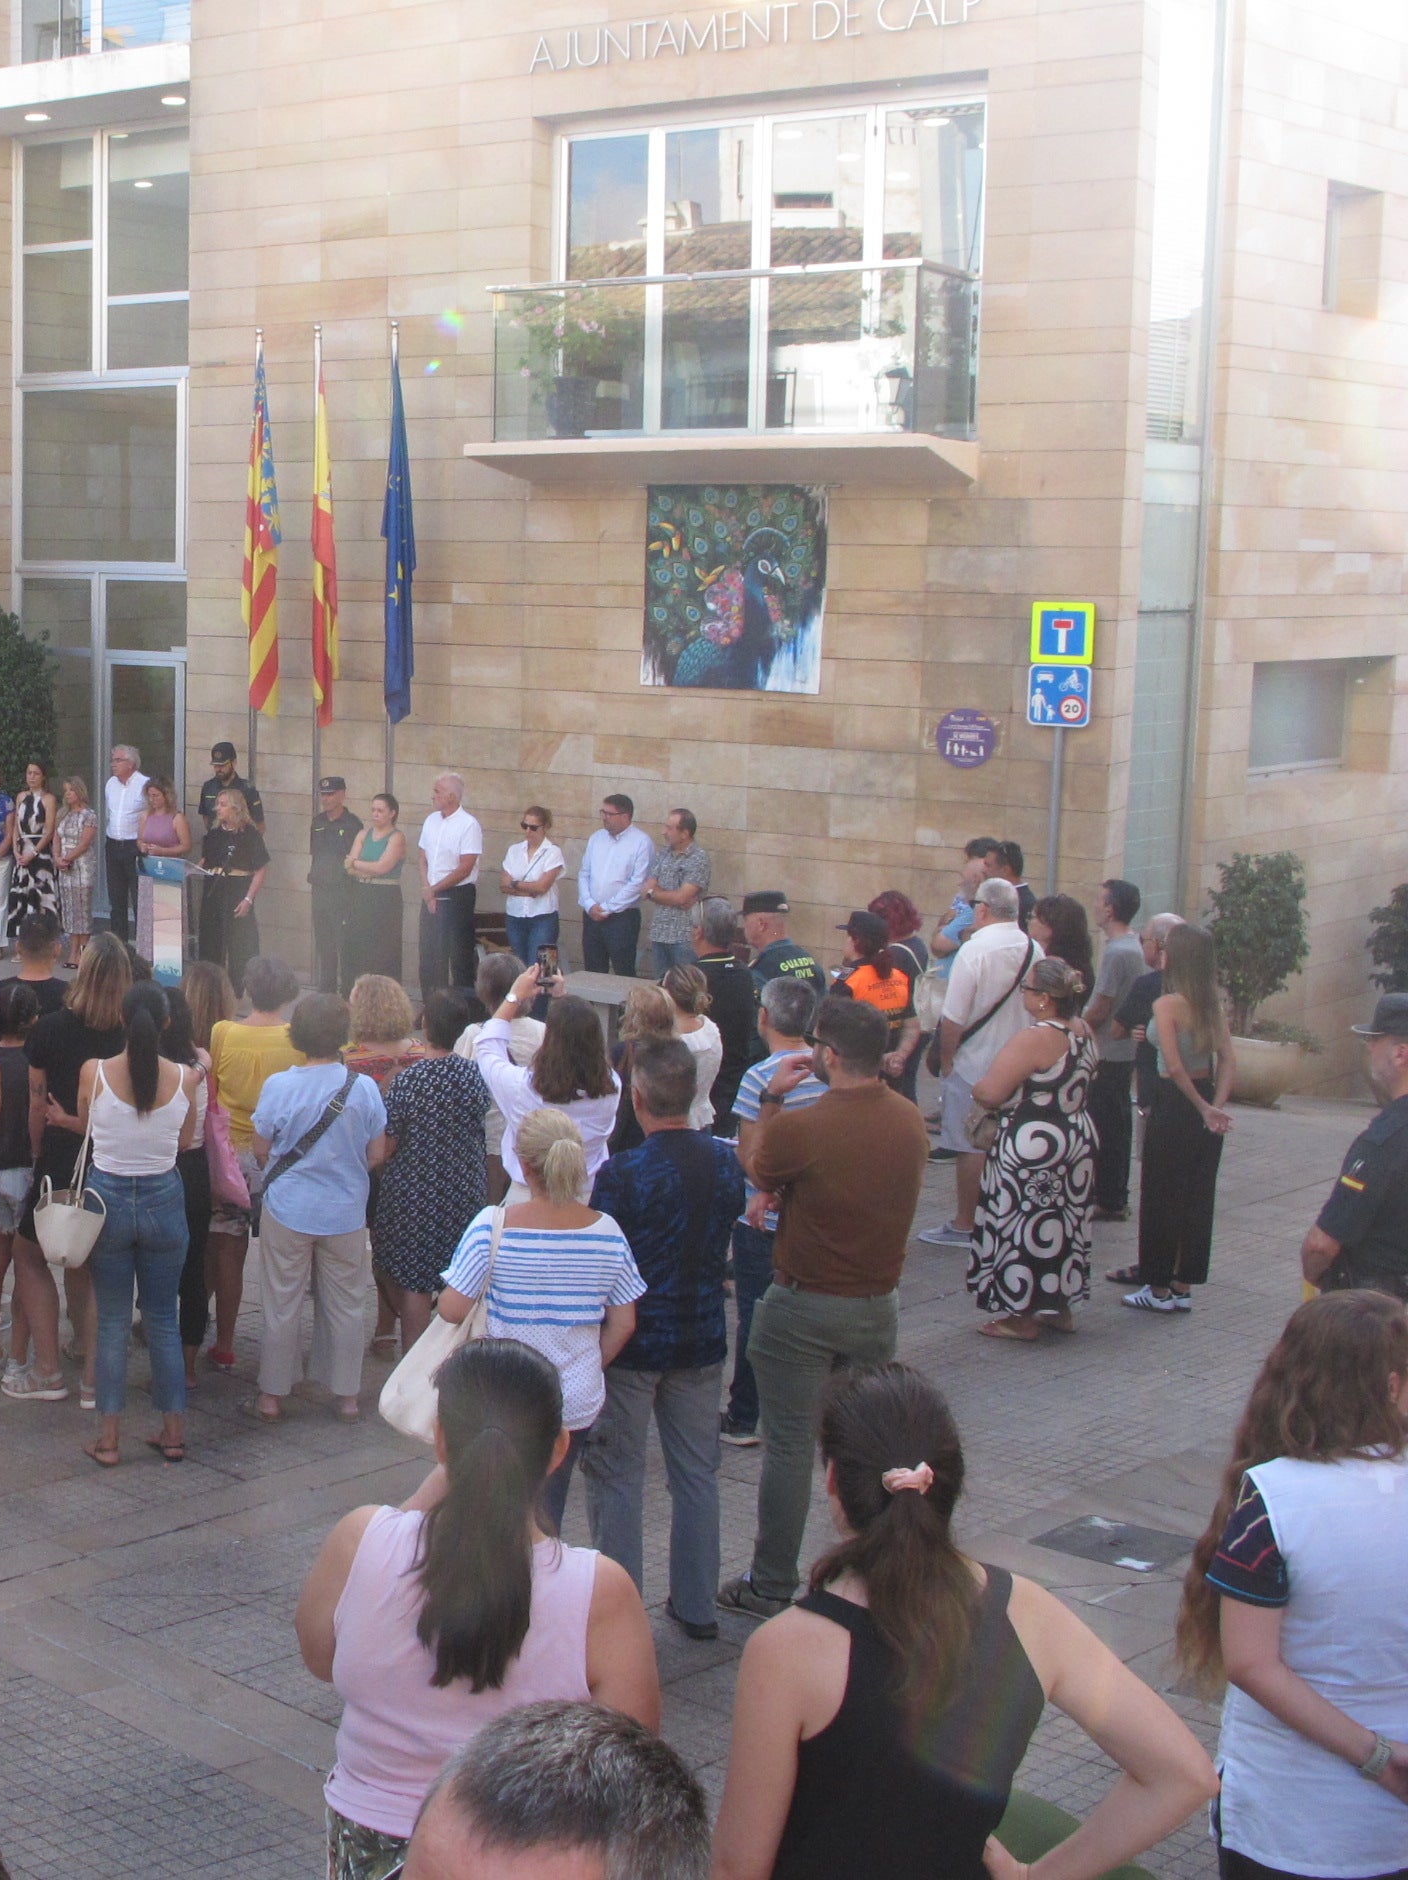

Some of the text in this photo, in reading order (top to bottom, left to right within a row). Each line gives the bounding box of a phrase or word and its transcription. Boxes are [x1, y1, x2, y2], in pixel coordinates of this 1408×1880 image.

[529, 1, 799, 74] AJUNTAMENT
[812, 0, 861, 41] DE
[1063, 703, 1080, 714] 20
[779, 956, 815, 972] GUARDIA
